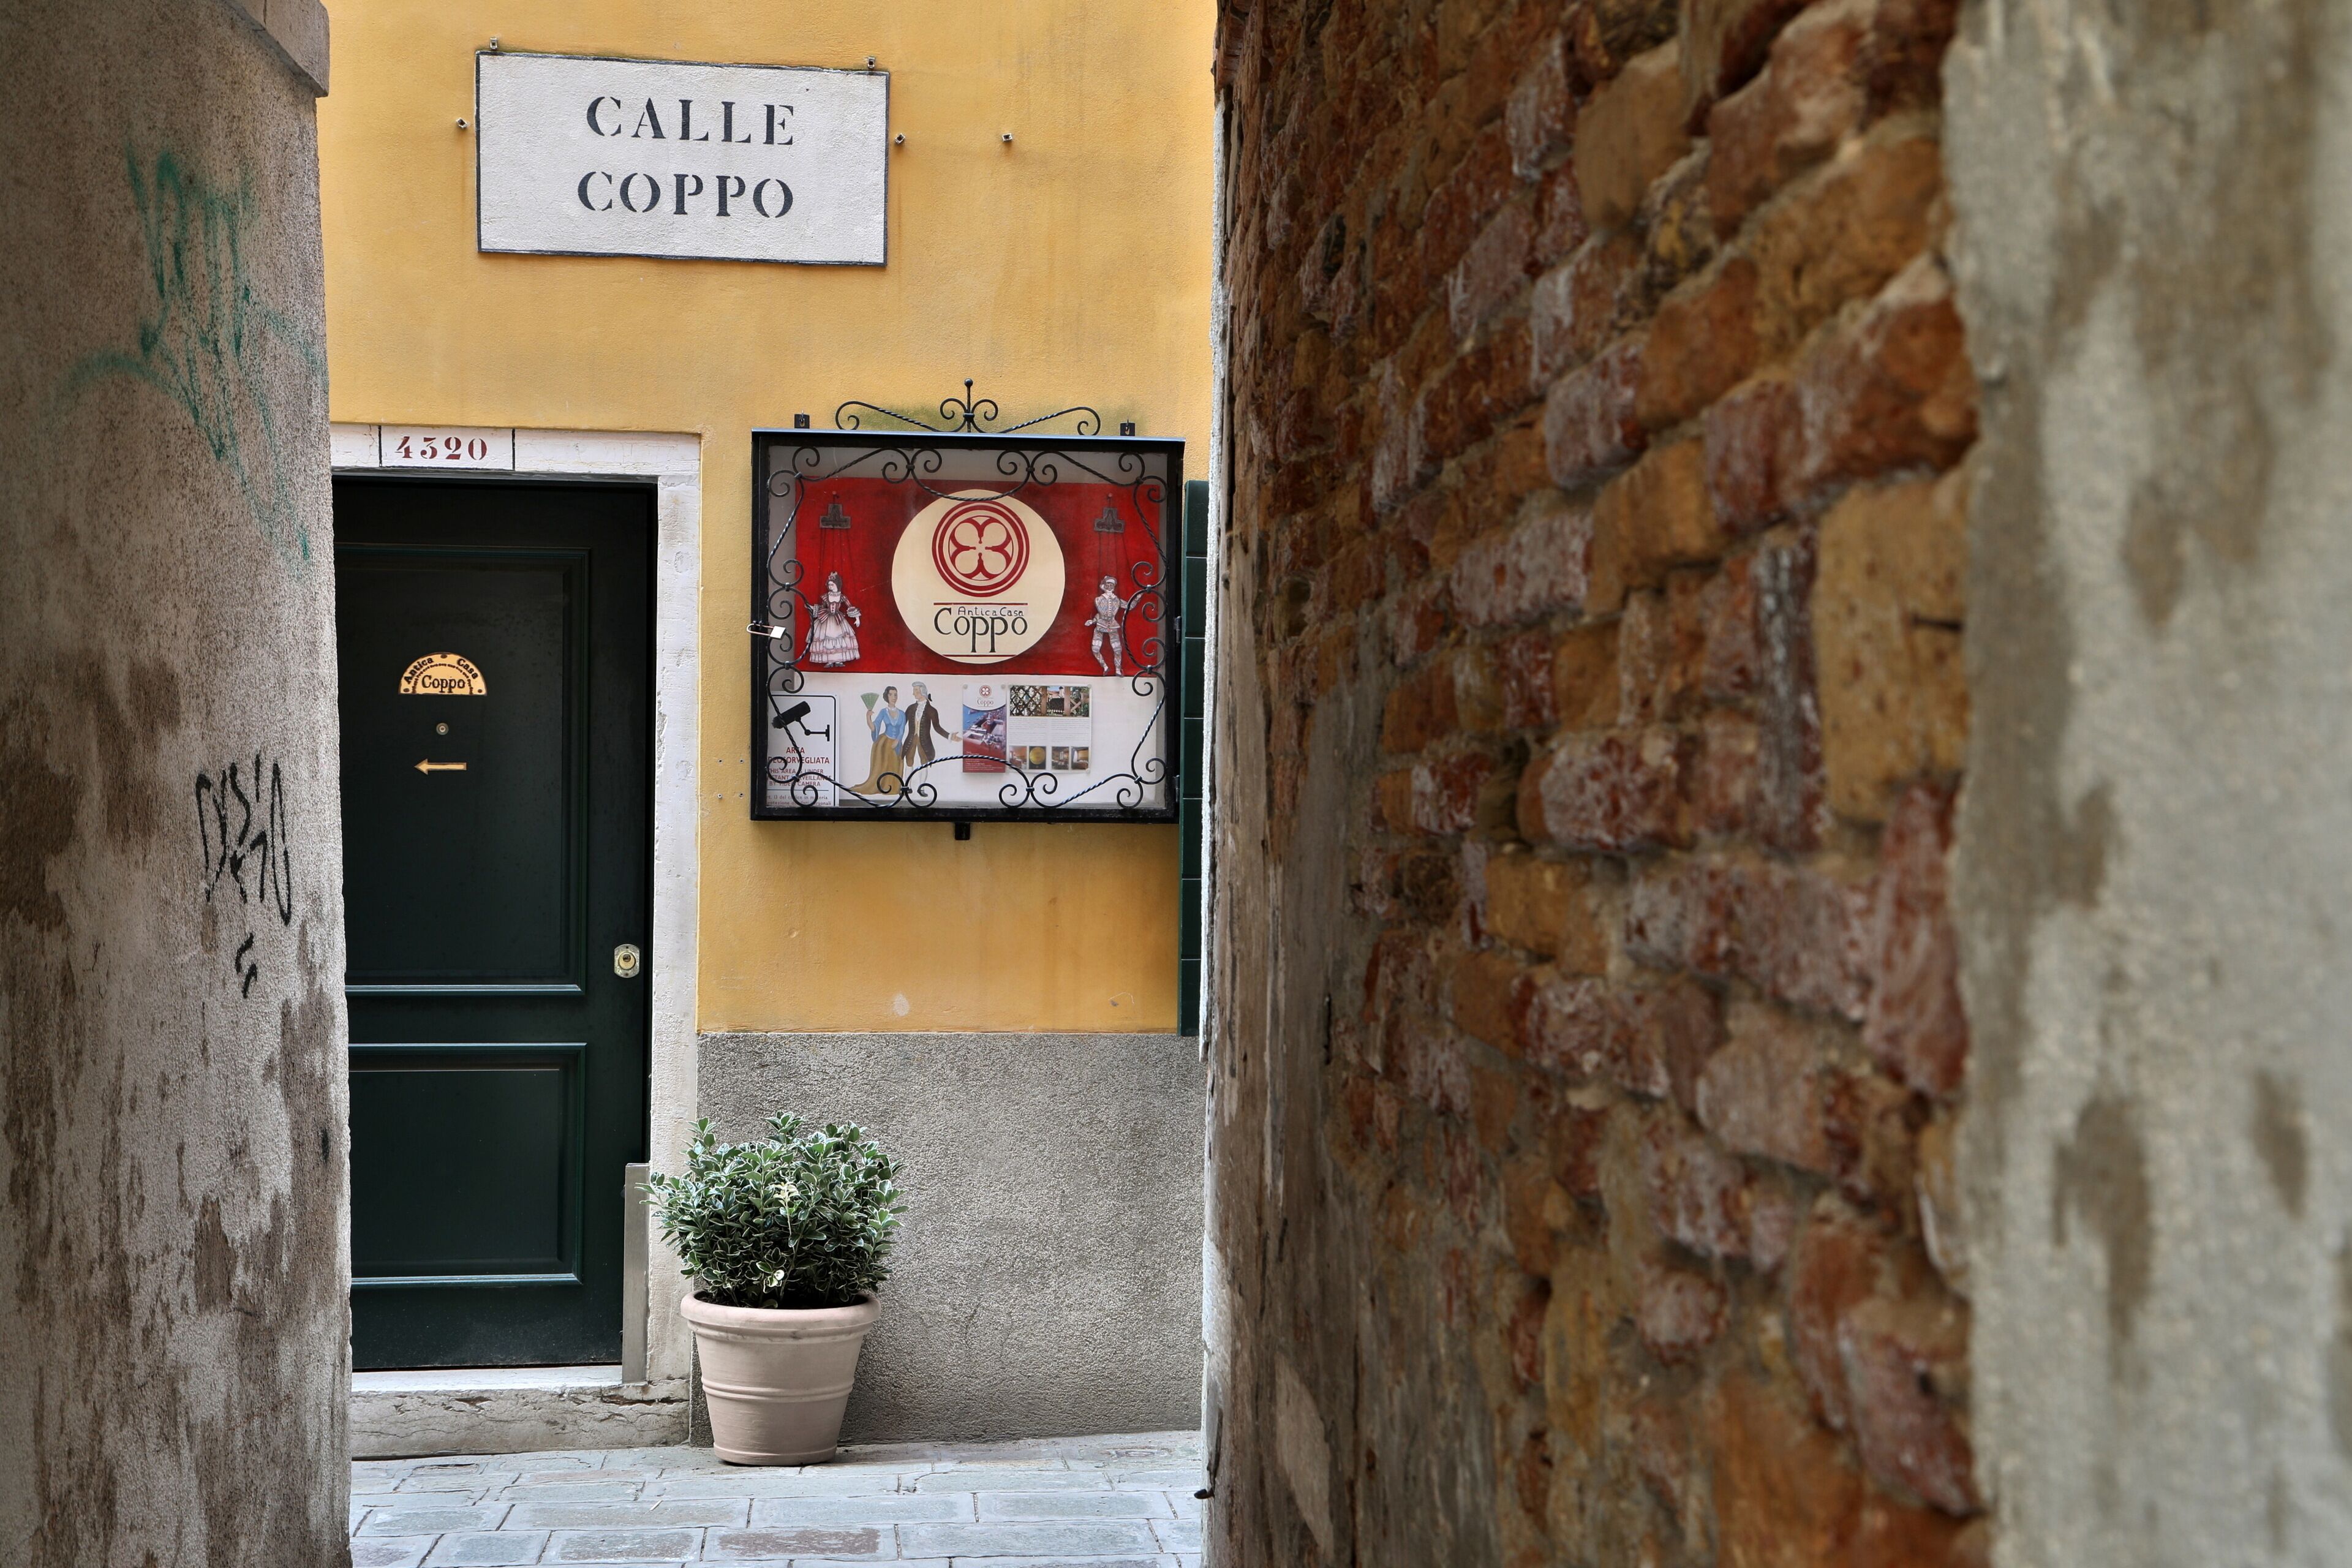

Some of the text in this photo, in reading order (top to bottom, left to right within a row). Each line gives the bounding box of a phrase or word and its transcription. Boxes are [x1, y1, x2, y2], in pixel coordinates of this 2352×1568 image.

[586, 96, 794, 146] CALLE
[578, 171, 793, 218] COPPO
[394, 435, 487, 460] 4320
[958, 606, 1024, 617] Antica Casa
[934, 607, 1028, 653] Coppo
[404, 657, 479, 685] Antica Casa
[421, 674, 466, 693] Coppo
